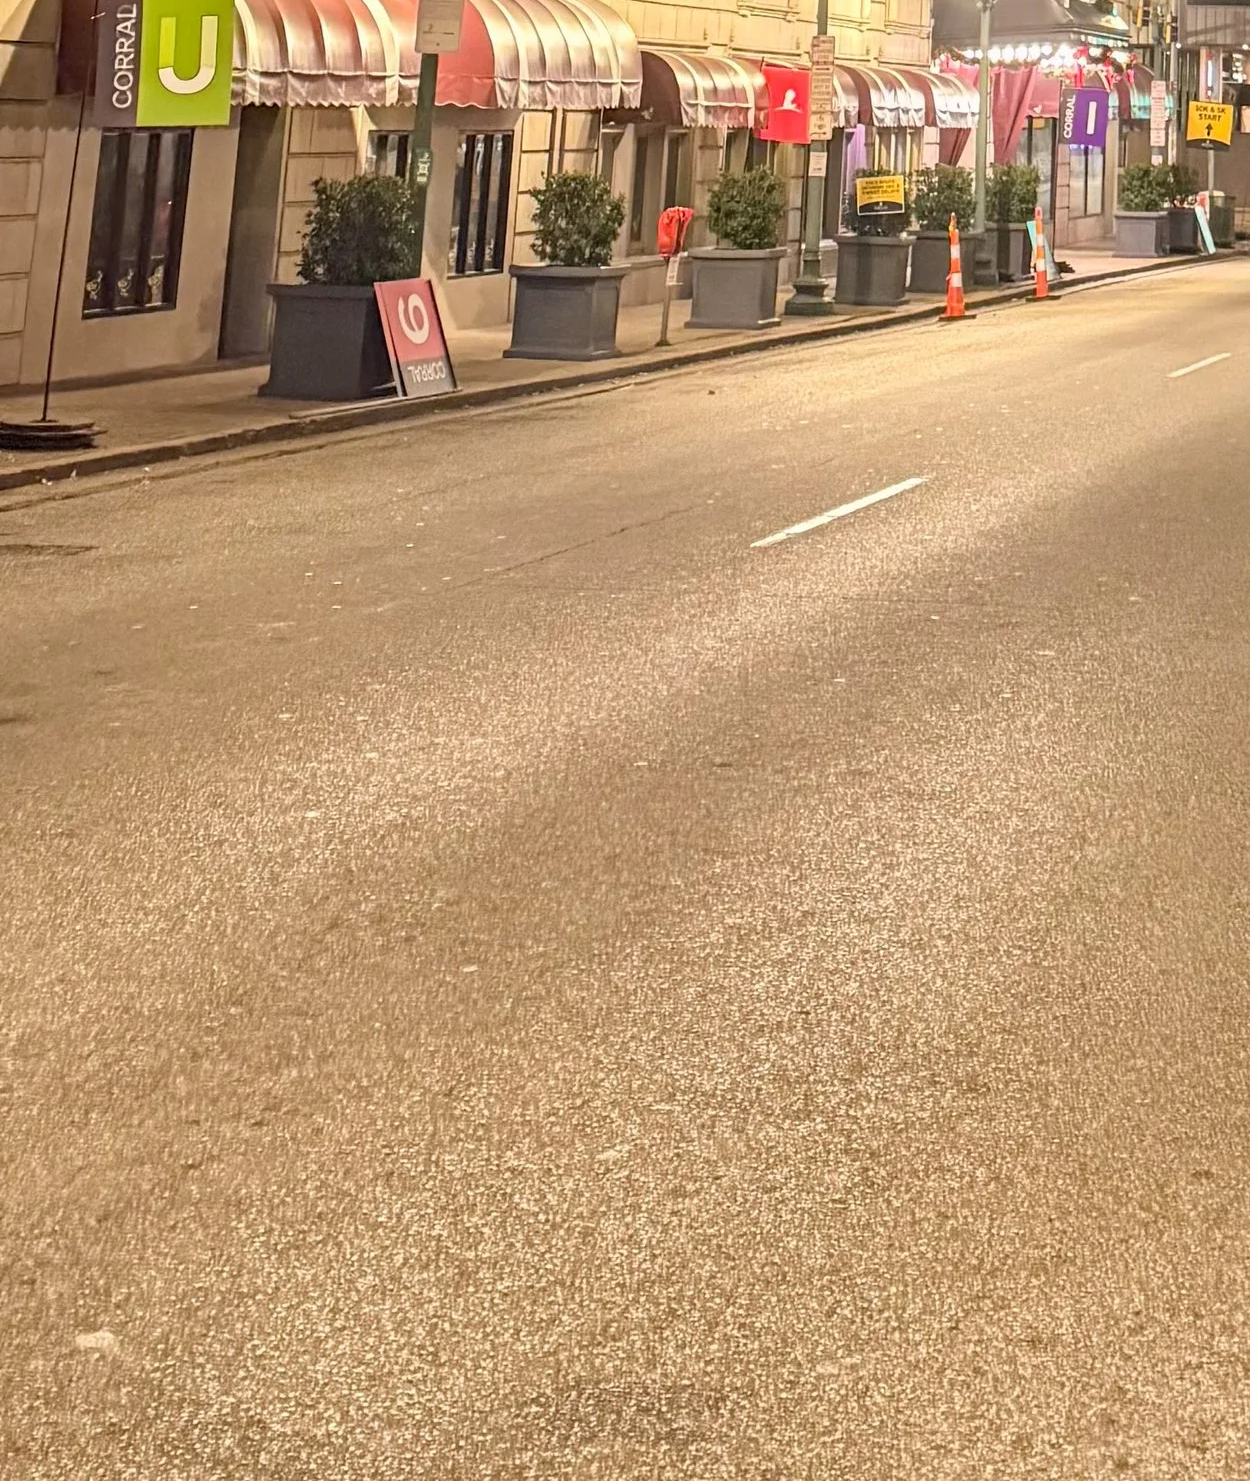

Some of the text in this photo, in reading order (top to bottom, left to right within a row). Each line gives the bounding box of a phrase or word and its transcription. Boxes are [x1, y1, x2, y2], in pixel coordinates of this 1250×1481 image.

[112, 3, 137, 109] CORRAL
[1063, 94, 1076, 139] CORRAL
[407, 360, 446, 383] CORRAL
